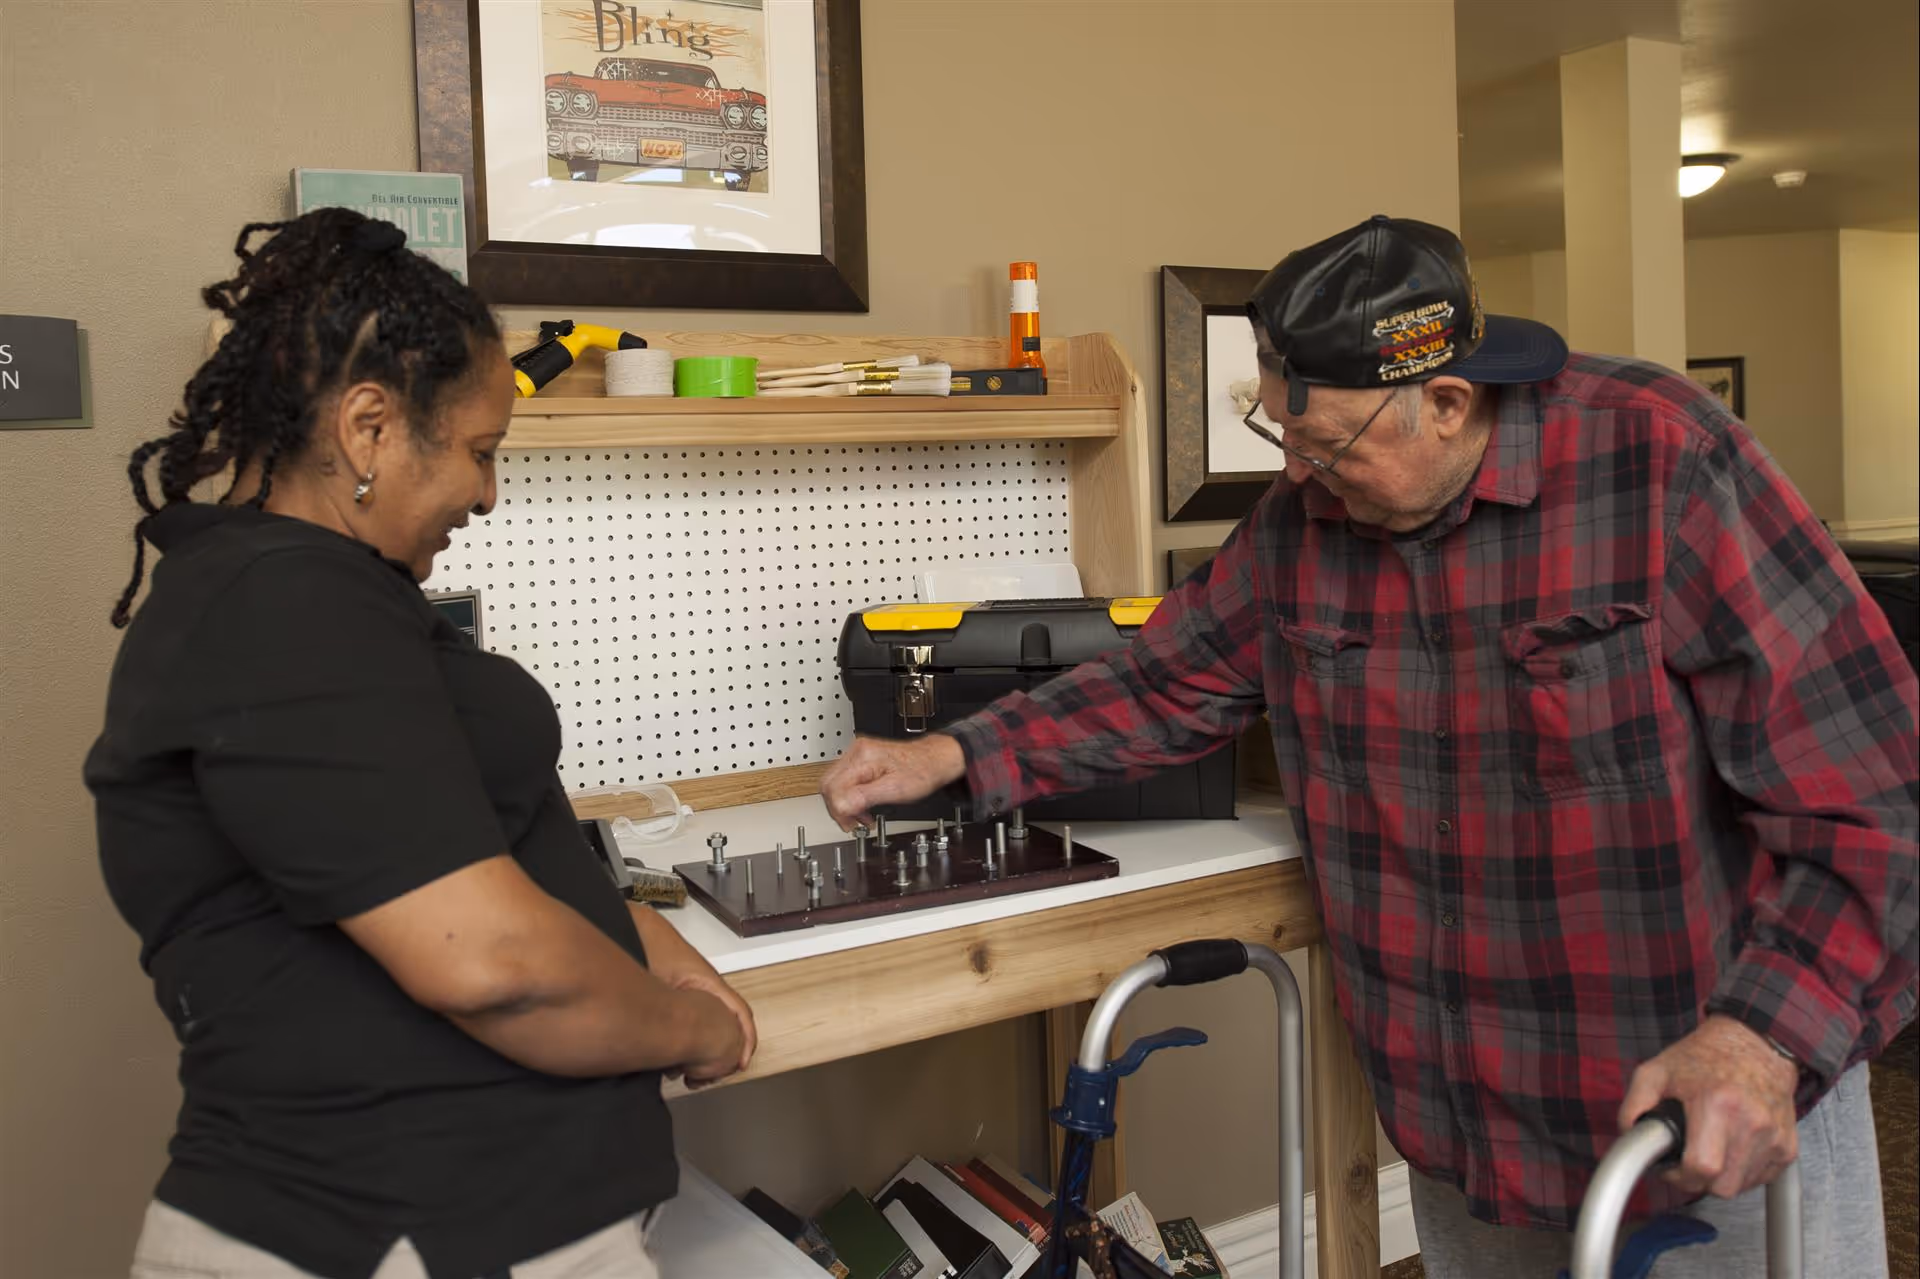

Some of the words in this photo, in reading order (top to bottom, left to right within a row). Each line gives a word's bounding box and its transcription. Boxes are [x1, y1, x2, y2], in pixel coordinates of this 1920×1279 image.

[593, 0, 713, 60] Bling
[1375, 310, 1415, 329] SUPER
[1416, 300, 1450, 317] BOWL
[1392, 320, 1443, 345] XXXII
[1381, 351, 1454, 381] CHAMPIONS
